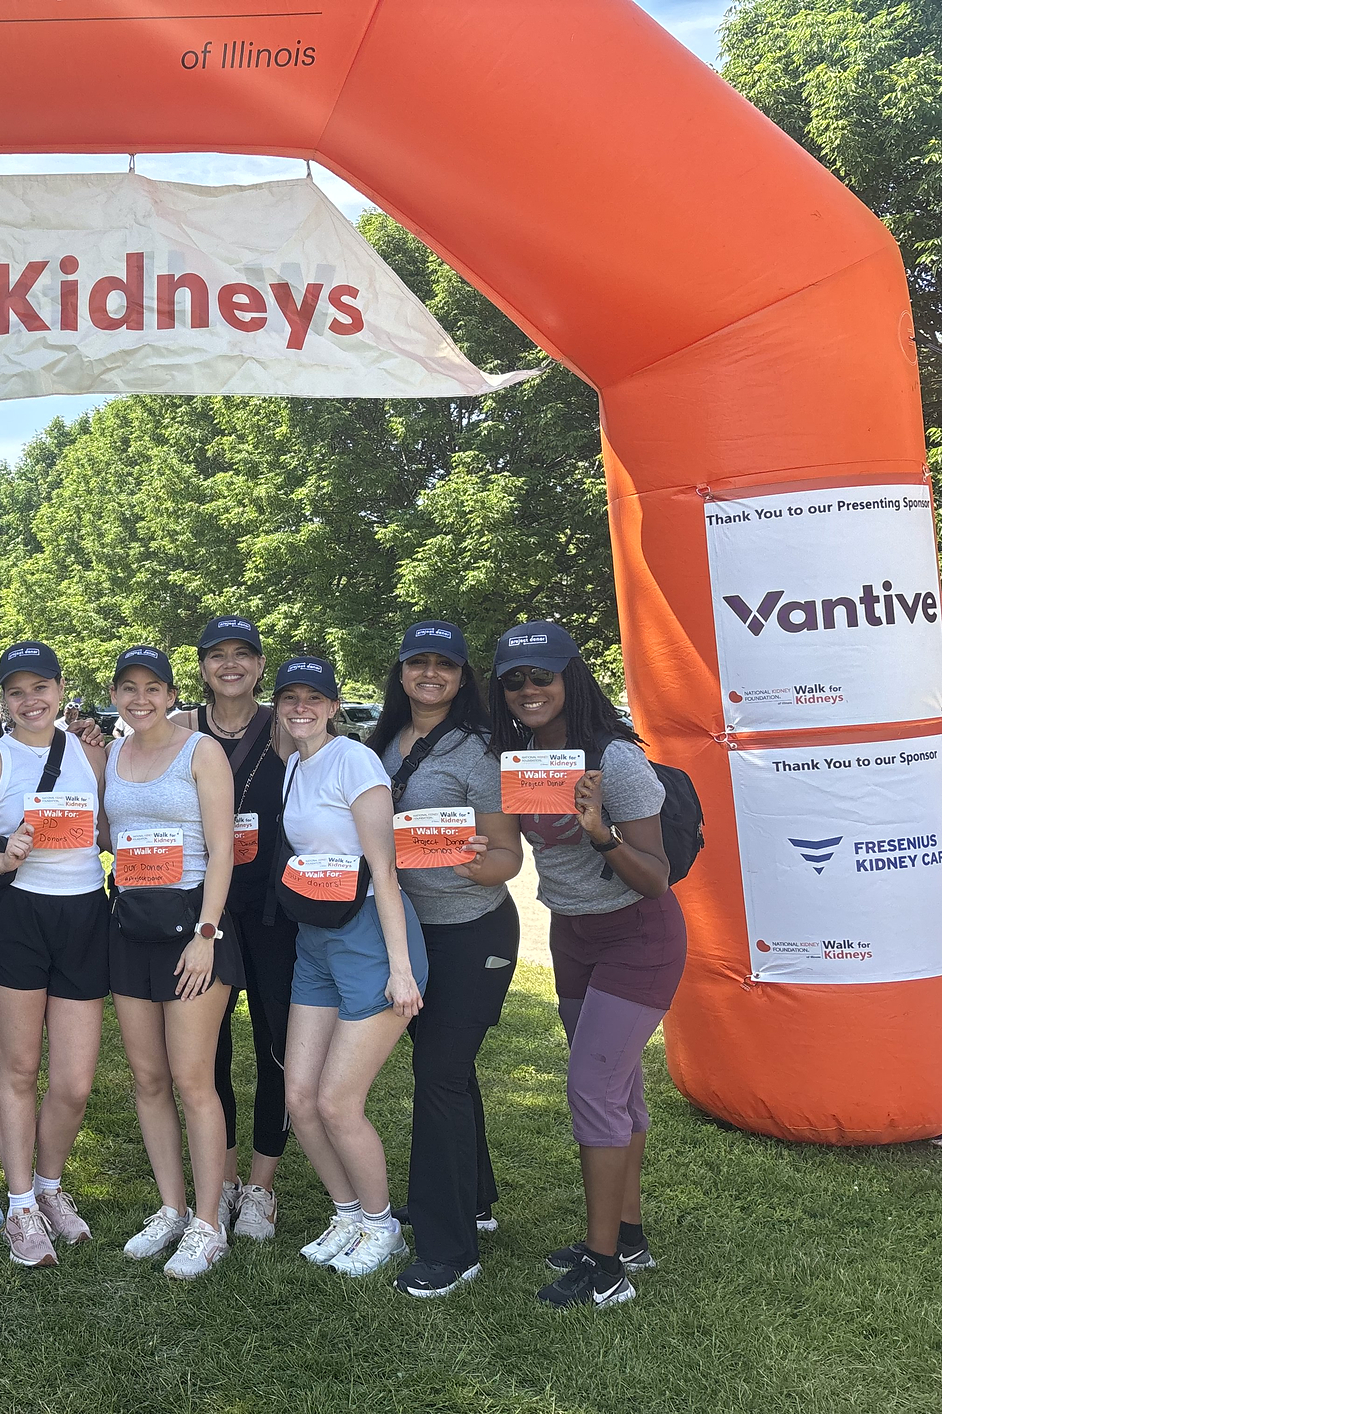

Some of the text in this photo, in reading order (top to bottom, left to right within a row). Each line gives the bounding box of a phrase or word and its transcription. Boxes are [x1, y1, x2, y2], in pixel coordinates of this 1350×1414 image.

[181, 40, 316, 70] of Illinois
[706, 497, 930, 525] Thank You to our Presenting Sponsor
[723, 580, 937, 636] Vantive
[794, 684, 825, 694] Walk
[796, 694, 844, 704] Kidneys
[772, 750, 938, 772] Thank You to our Sponsor
[521, 780, 544, 790] Project
[42, 818, 58, 828] PD
[40, 834, 67, 842] Donors
[412, 836, 439, 846] Project
[854, 834, 937, 854] FRESENIUS
[856, 854, 917, 872] KIDNEY
[823, 940, 854, 949] Walk
[824, 951, 872, 961] Kidneys
